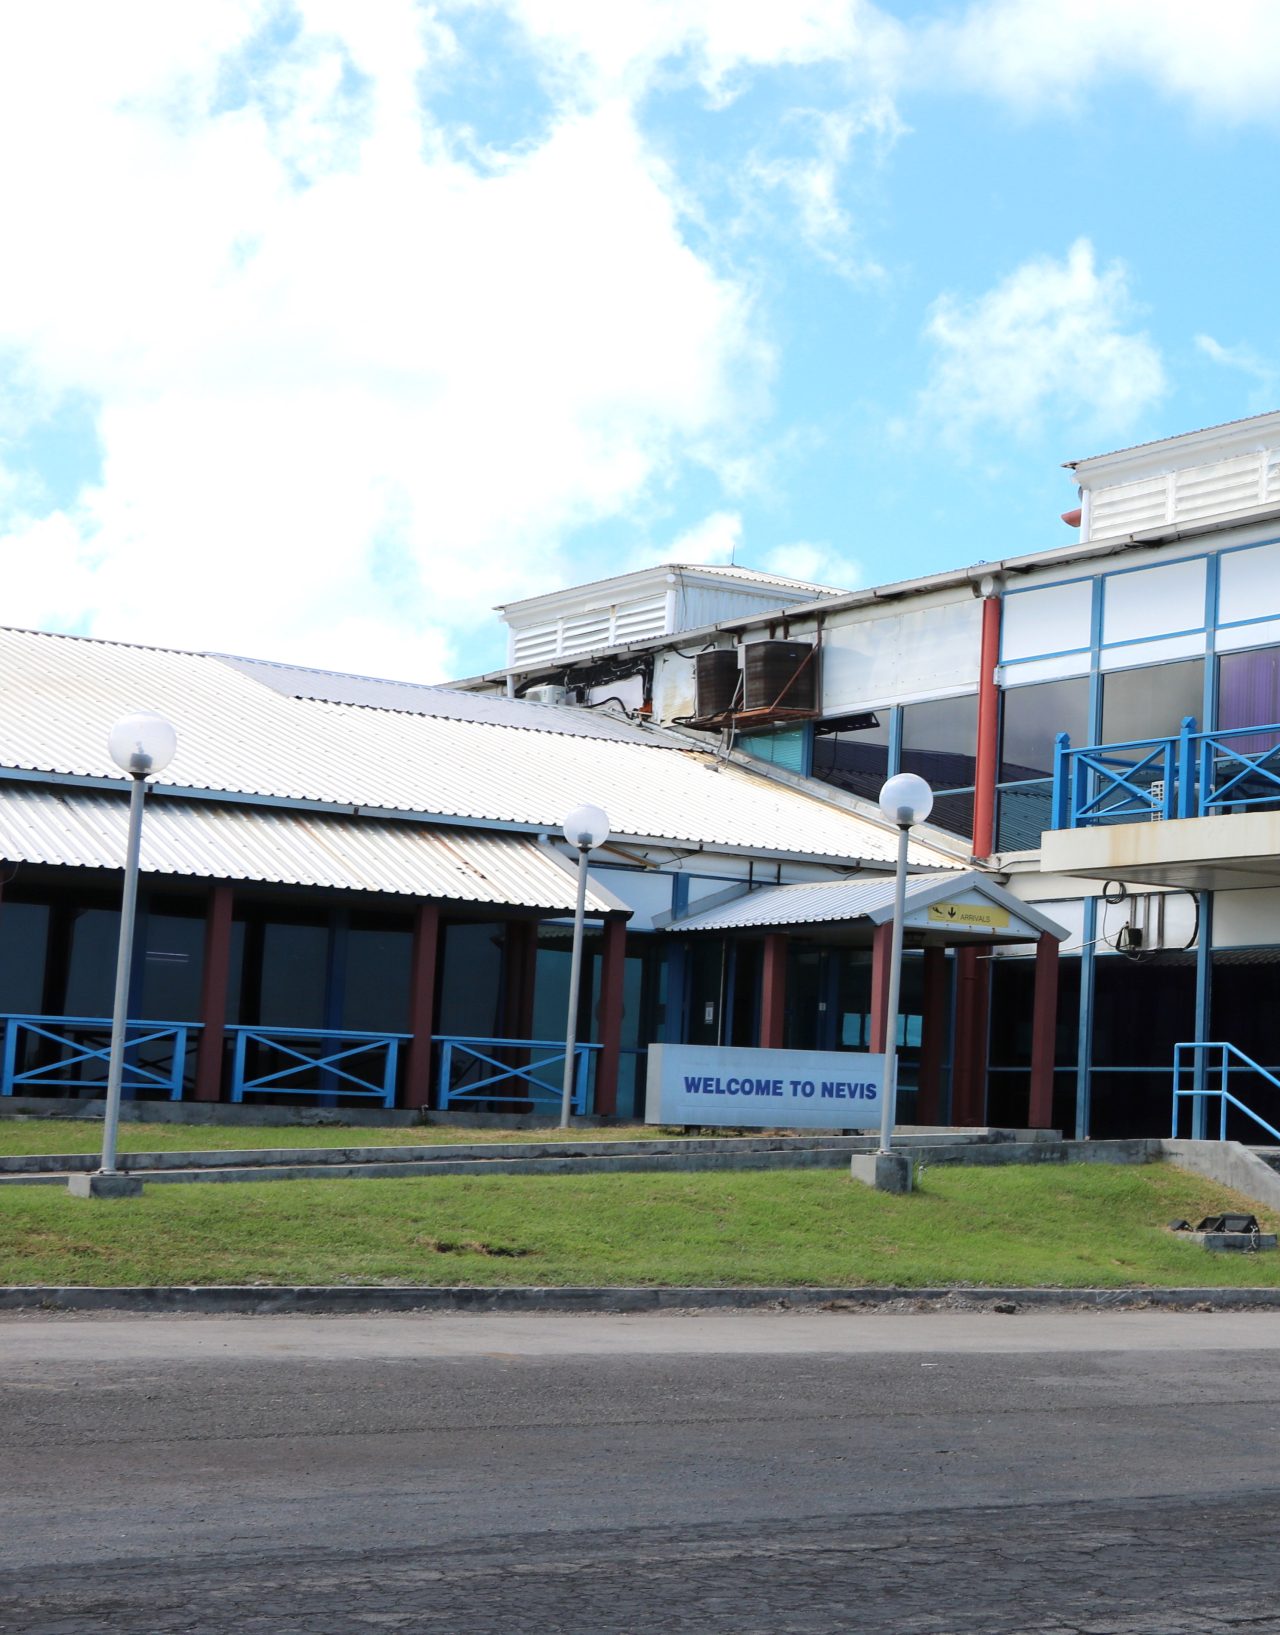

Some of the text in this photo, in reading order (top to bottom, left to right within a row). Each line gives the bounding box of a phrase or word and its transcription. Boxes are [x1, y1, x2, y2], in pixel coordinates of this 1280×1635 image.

[959, 913, 991, 923] ARRIVALS
[684, 1076, 877, 1100] WELCOME TO NEVIS
